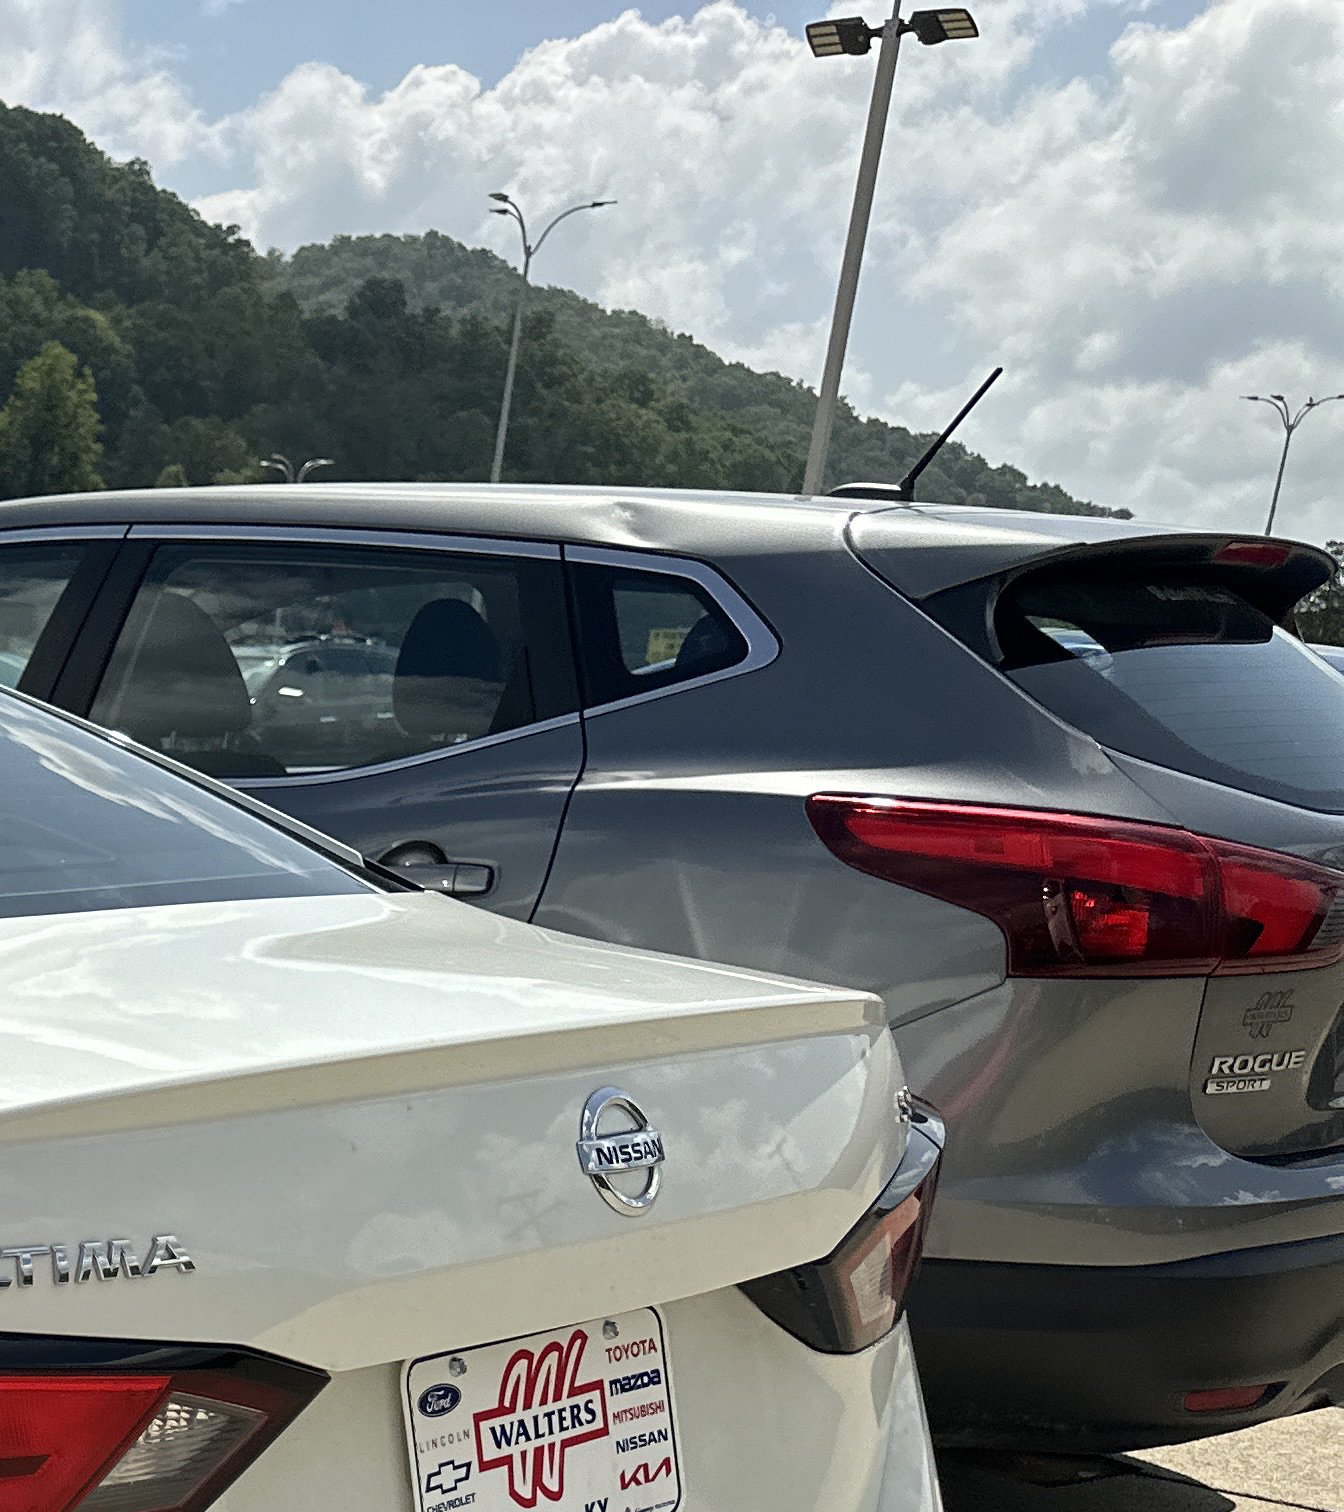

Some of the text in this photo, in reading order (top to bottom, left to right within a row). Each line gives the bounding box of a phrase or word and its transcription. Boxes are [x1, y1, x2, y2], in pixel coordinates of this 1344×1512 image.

[1211, 1051, 1306, 1075] ROGUE
[1215, 1079, 1265, 1093] SPORT
[595, 1137, 663, 1166] NISSAN
[605, 1338, 657, 1364] TOYOTA
[489, 1399, 597, 1450] WALTERS
[612, 1400, 665, 1425] MITSUBISHI
[419, 1429, 470, 1453] LINCOLN
[616, 1428, 668, 1454] NISSAN
